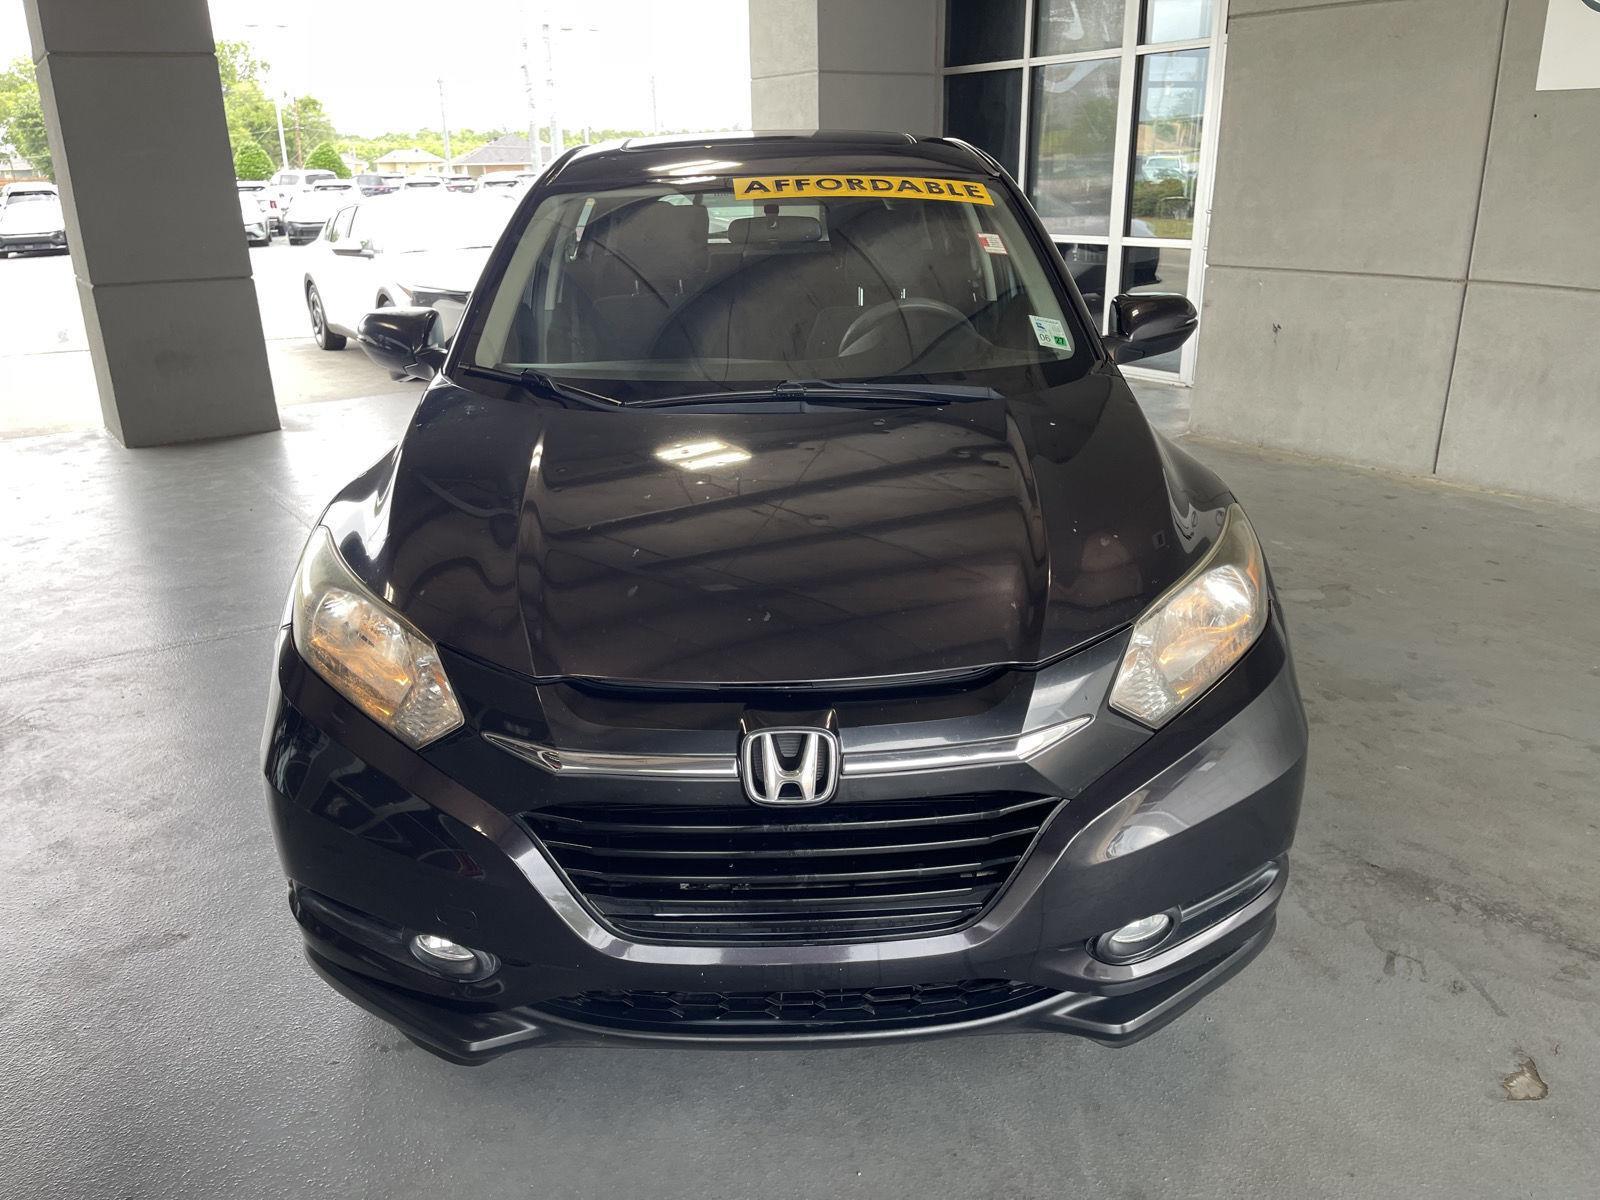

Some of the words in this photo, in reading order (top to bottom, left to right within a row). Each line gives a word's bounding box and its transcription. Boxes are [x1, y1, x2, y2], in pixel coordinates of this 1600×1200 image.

[743, 178, 985, 199] AFFORDABLE
[1039, 333, 1051, 342] 06
[1054, 336, 1065, 345] 27
